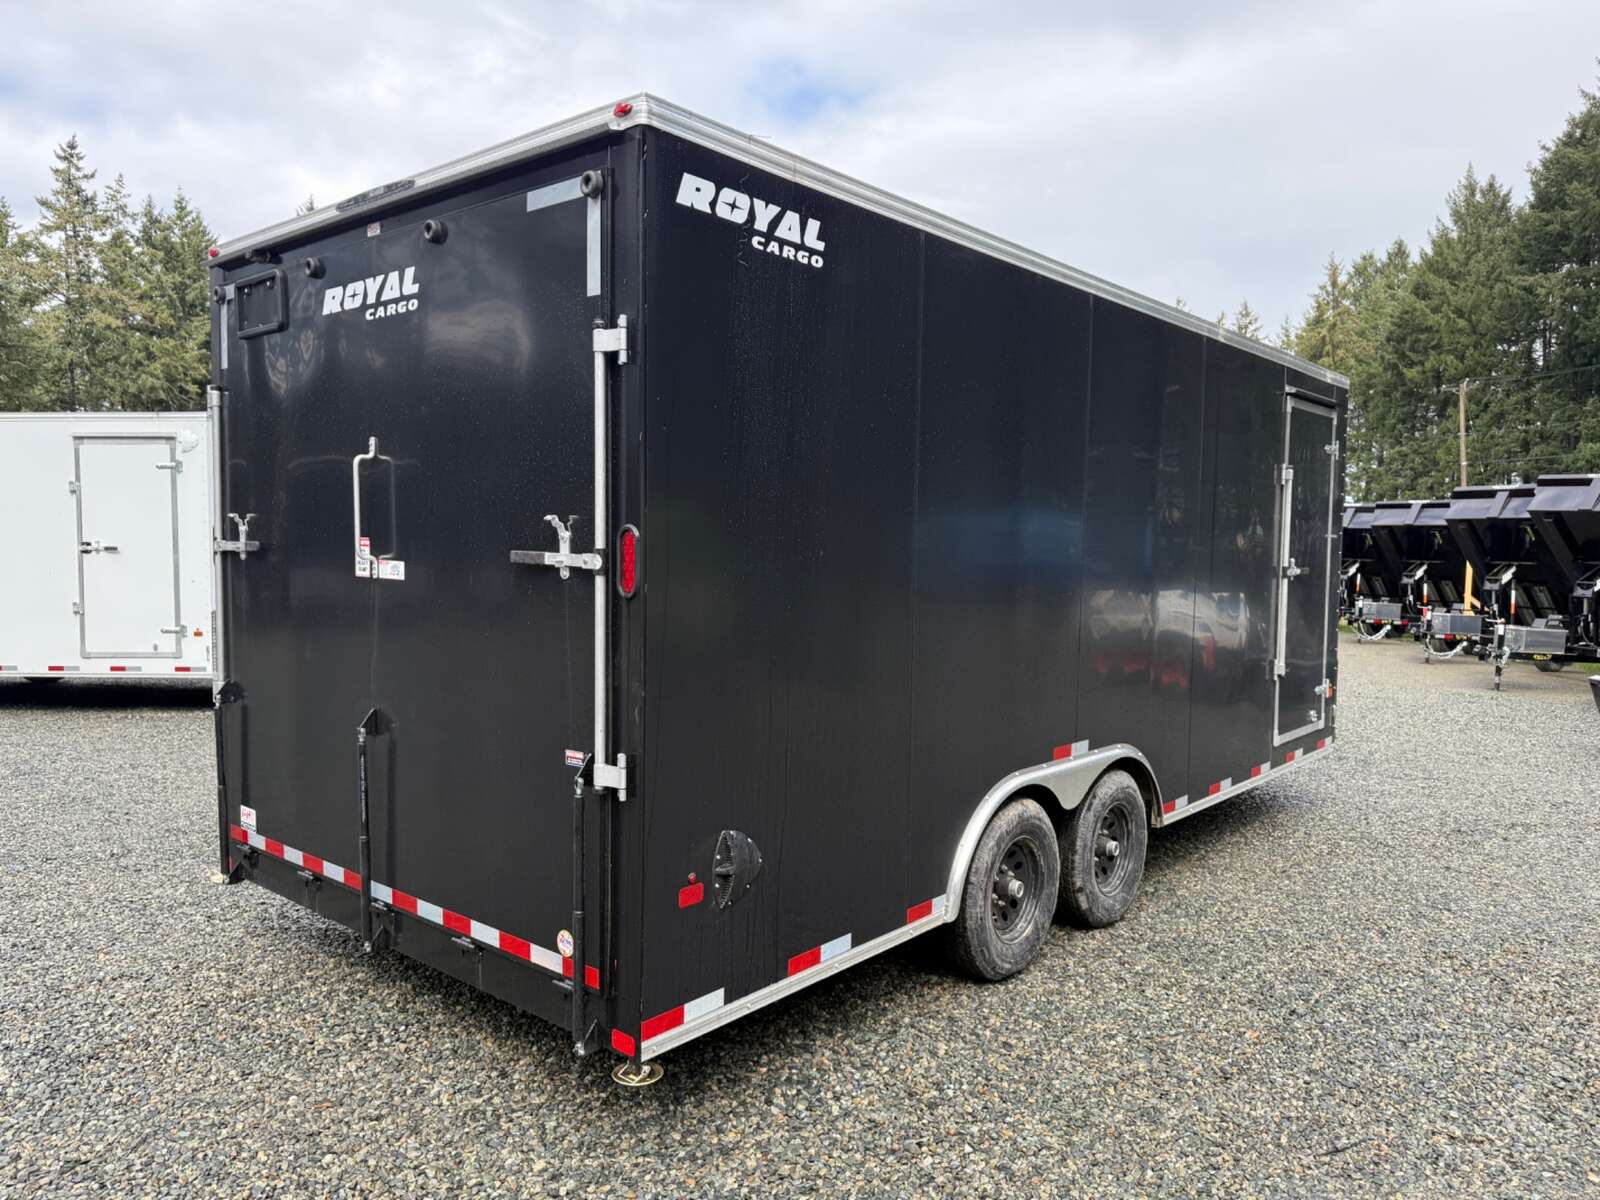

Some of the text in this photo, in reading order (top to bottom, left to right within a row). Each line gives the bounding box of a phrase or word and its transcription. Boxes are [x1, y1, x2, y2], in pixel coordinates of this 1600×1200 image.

[675, 172, 826, 252] ROYAL
[751, 236, 824, 268] CARGO
[322, 266, 420, 316] ROYAL
[365, 299, 419, 321] CARGO
